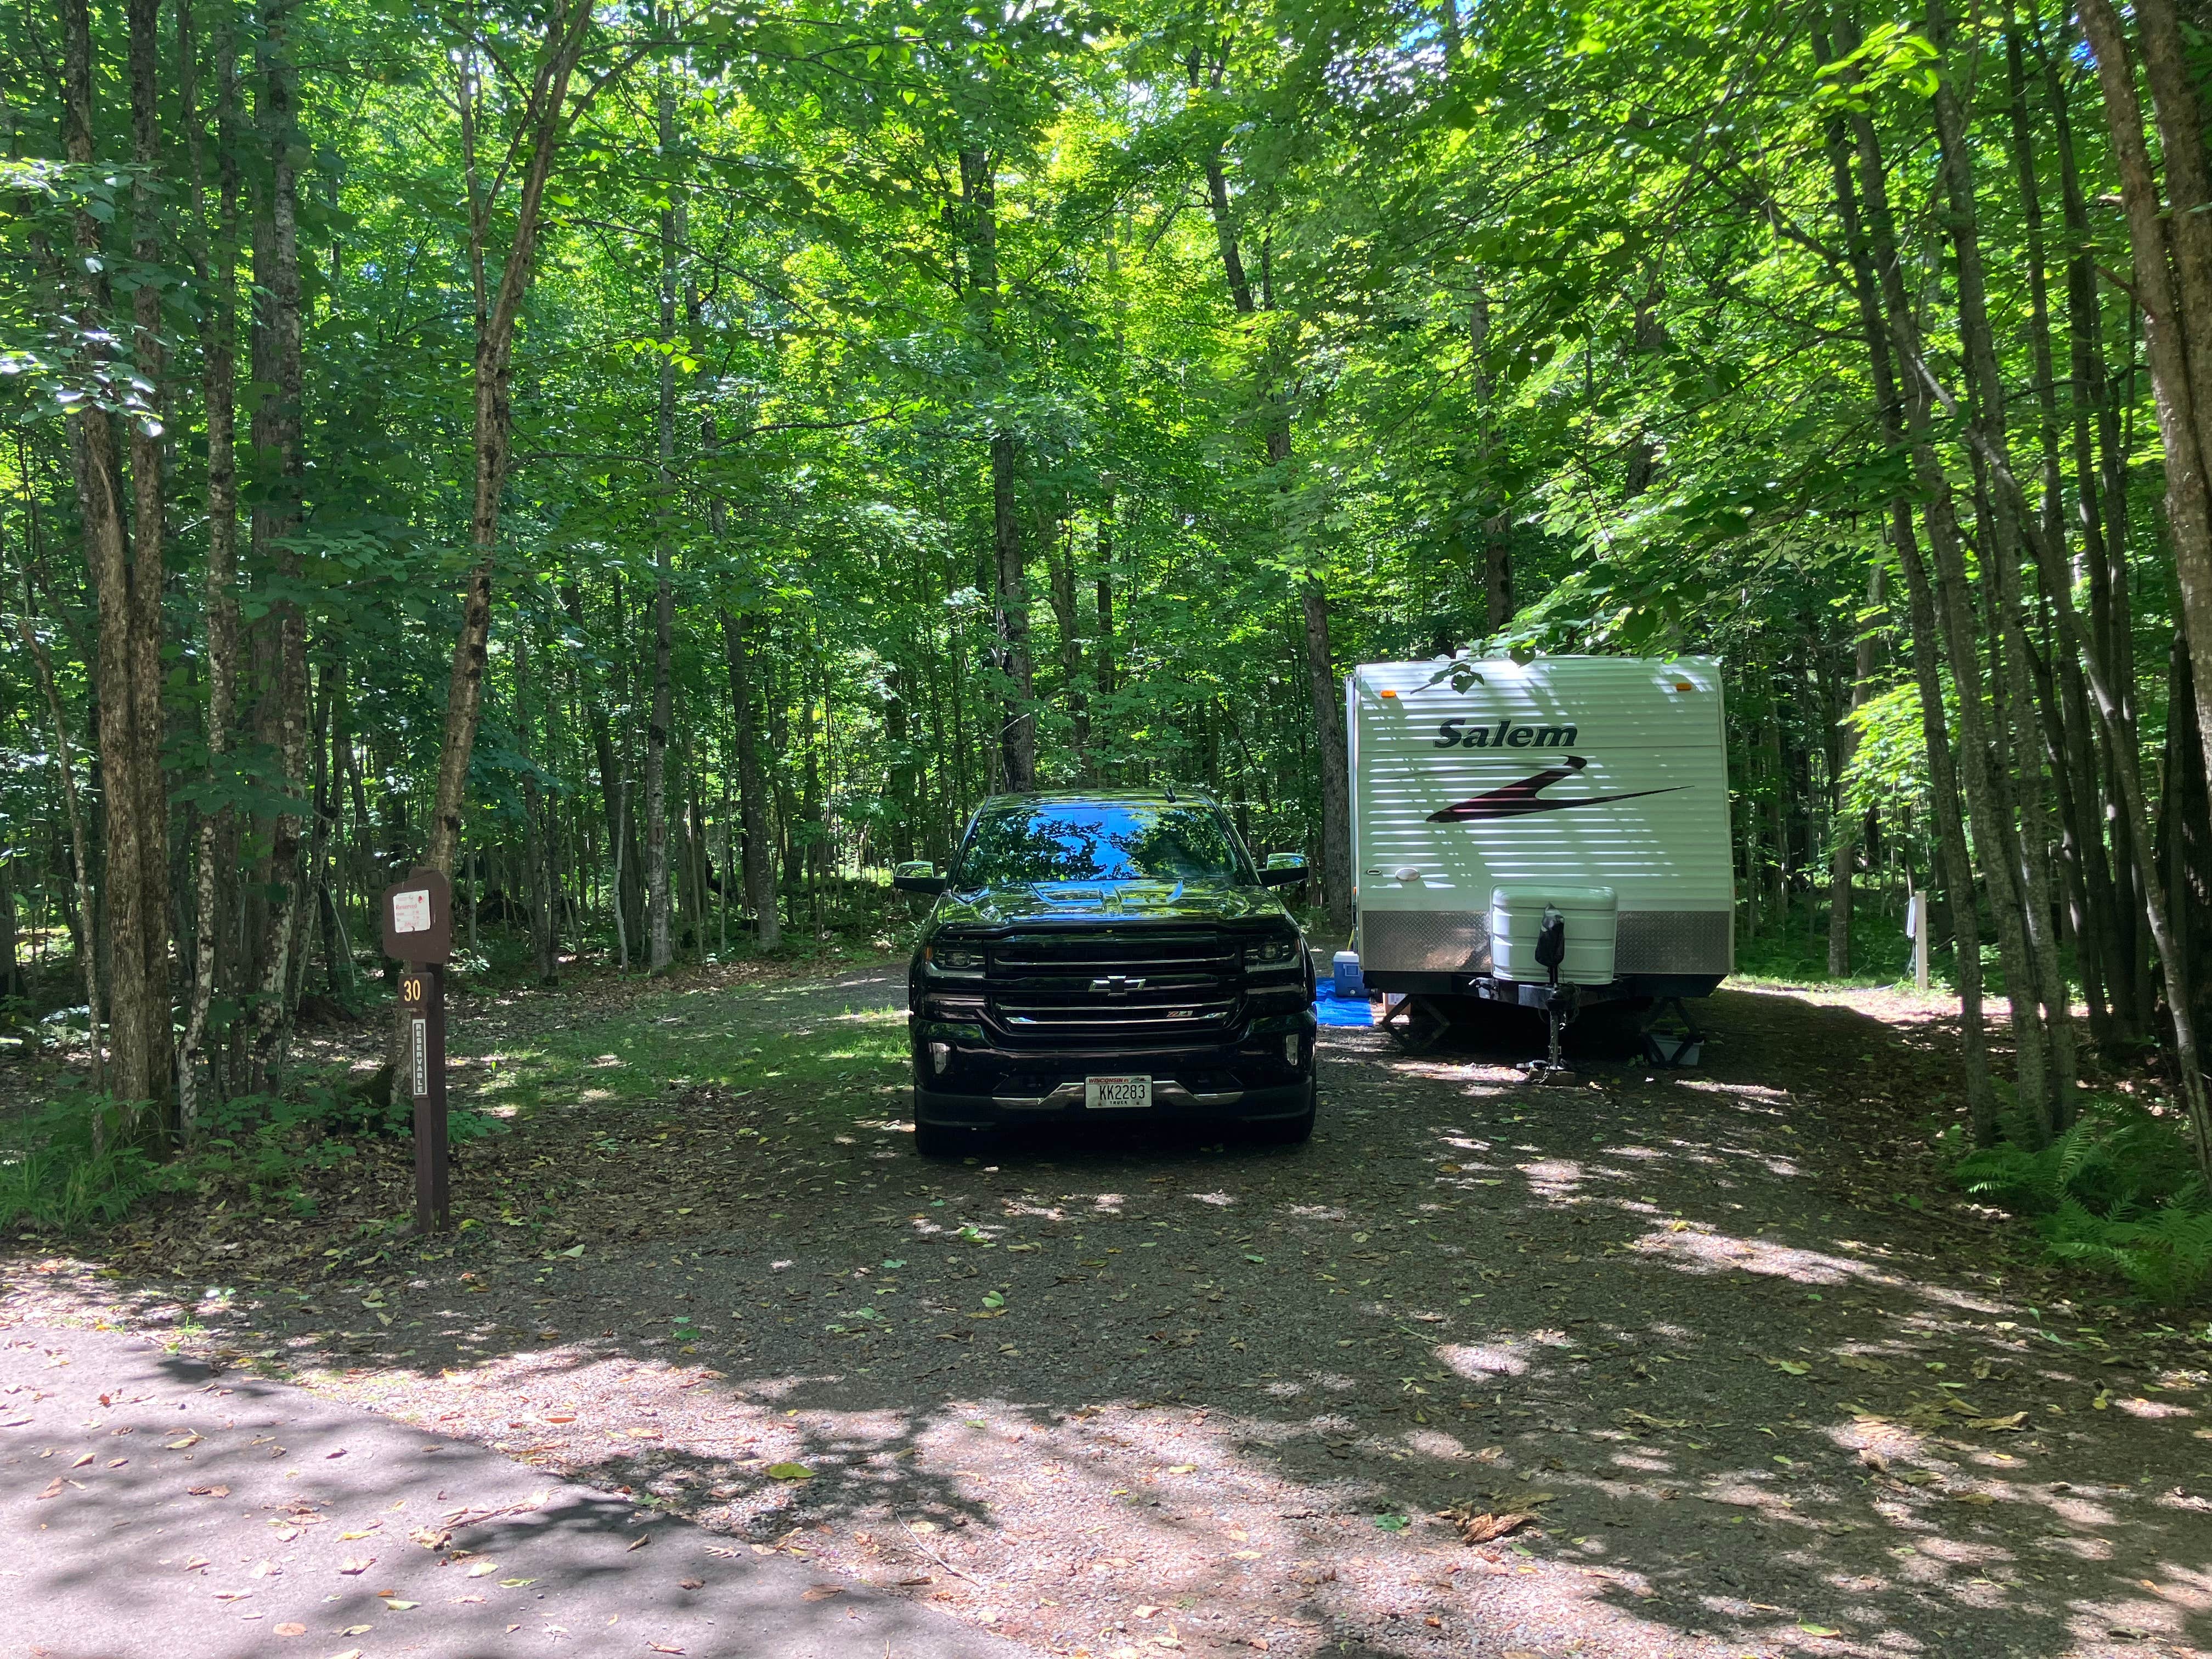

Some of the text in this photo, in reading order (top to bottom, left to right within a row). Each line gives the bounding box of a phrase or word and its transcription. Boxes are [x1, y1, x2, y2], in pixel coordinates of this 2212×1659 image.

[1434, 718, 1578, 748] Salem
[404, 979, 421, 1001] 30
[1099, 1084, 1145, 1100] KK2283
